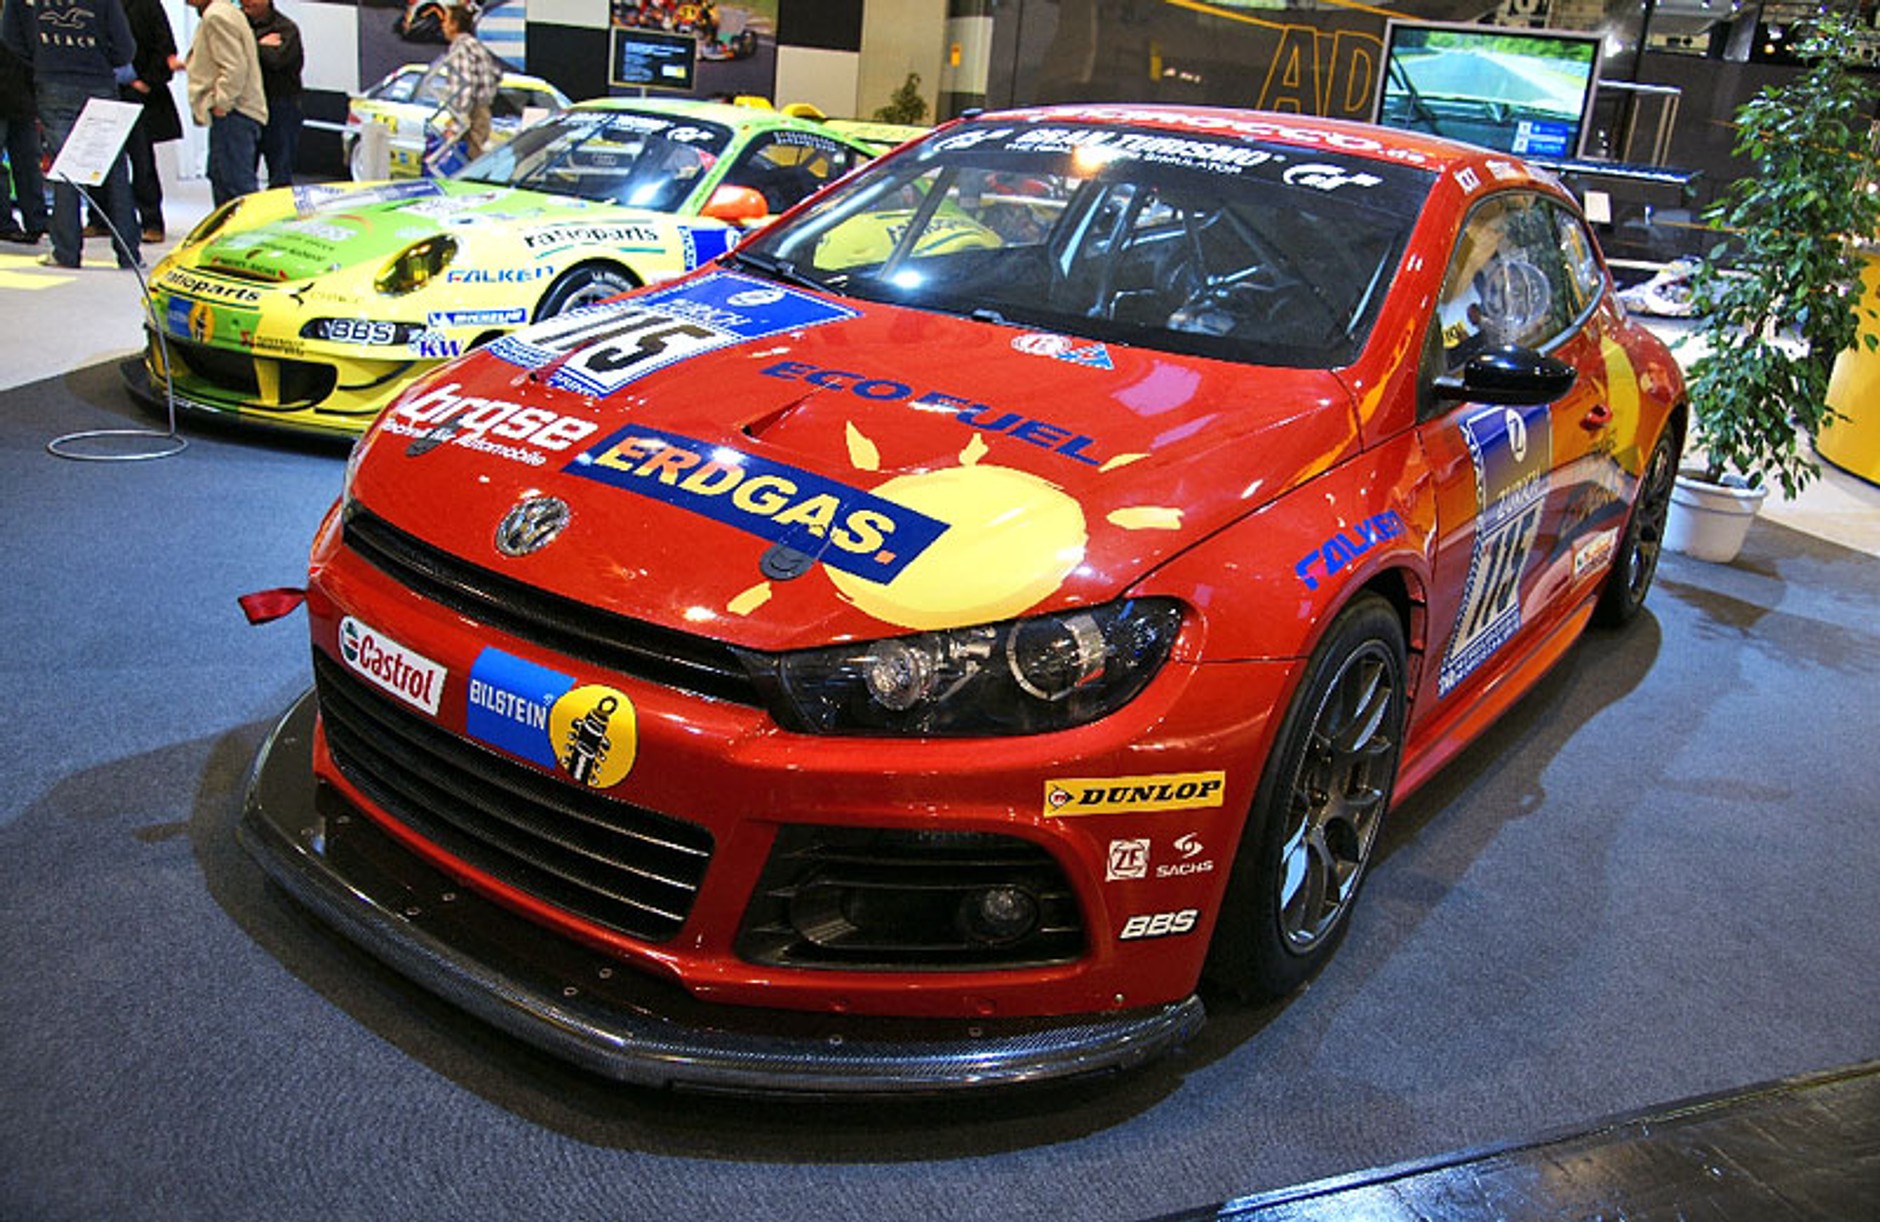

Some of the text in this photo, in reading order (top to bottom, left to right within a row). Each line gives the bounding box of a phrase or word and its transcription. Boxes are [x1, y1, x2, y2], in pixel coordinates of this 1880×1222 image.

[331, 319, 394, 344] BBS
[398, 382, 599, 451] brose
[358, 634, 435, 707] Castrol
[469, 678, 548, 731] BILSTEIN
[1078, 780, 1221, 806] DUNLOP
[1156, 860, 1214, 878] SACHS
[1119, 909, 1199, 940] BBS
